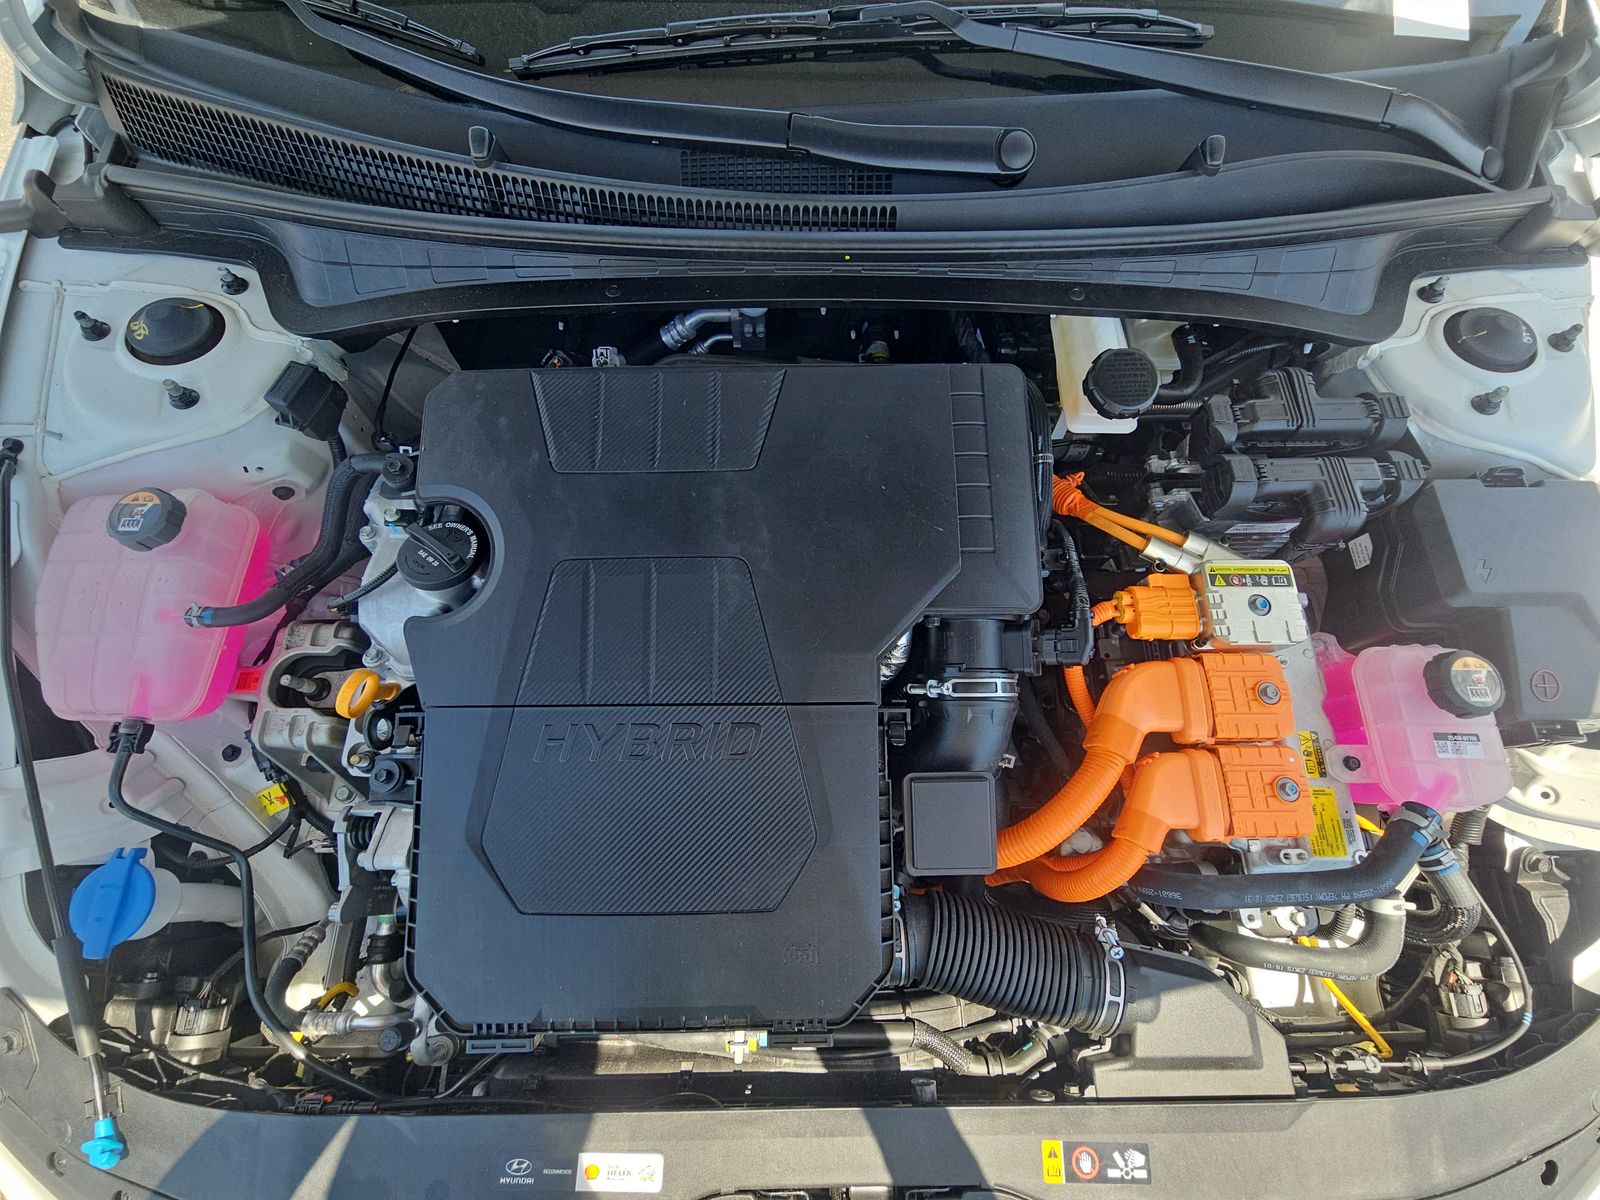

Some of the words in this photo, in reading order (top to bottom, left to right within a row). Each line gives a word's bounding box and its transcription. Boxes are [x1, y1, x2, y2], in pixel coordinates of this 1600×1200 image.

[428, 522, 443, 531] SEE
[445, 521, 474, 536] OWNER'S
[466, 535, 478, 559] MANUAL
[417, 549, 429, 558] SAE
[532, 721, 764, 763] HYBRID
[499, 1176, 535, 1185] HYUNDAI
